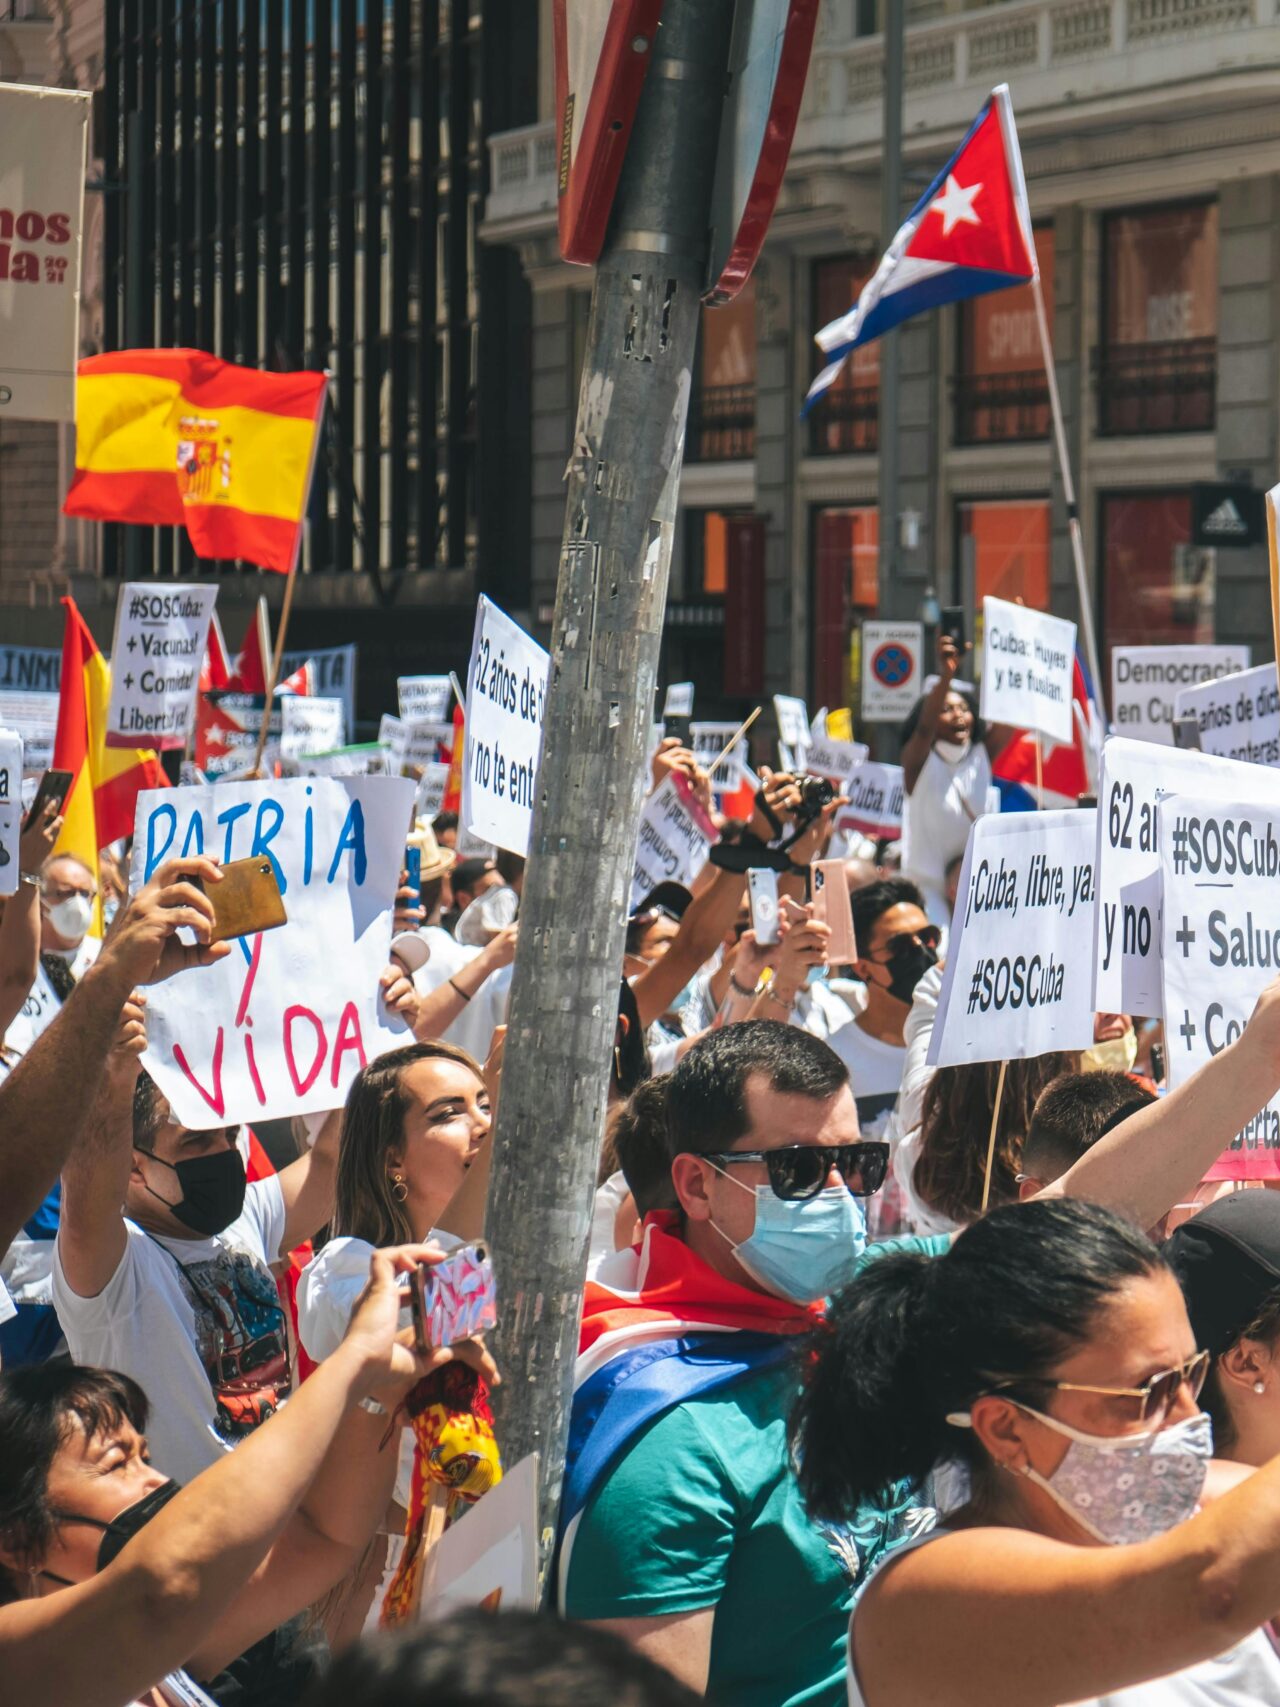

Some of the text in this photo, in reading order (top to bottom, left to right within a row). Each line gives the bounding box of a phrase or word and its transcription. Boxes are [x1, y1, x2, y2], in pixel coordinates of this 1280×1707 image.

[129, 595, 204, 619] #SOSCuba:
[141, 631, 199, 657] Vacunas!
[989, 629, 1029, 658] Cuba:
[994, 668, 1005, 691] y
[1008, 671, 1023, 691] te
[1117, 657, 1244, 684] Democracia
[489, 649, 517, 715] años
[520, 666, 537, 724] de
[1118, 702, 1140, 723] en
[1235, 693, 1254, 723] de
[493, 741, 506, 798] te
[1109, 780, 1134, 849] 62
[966, 854, 1096, 928] ¡Cuba, libre, ya!
[1103, 901, 1151, 972] y no
[968, 953, 1065, 1016] #SOSCuba
